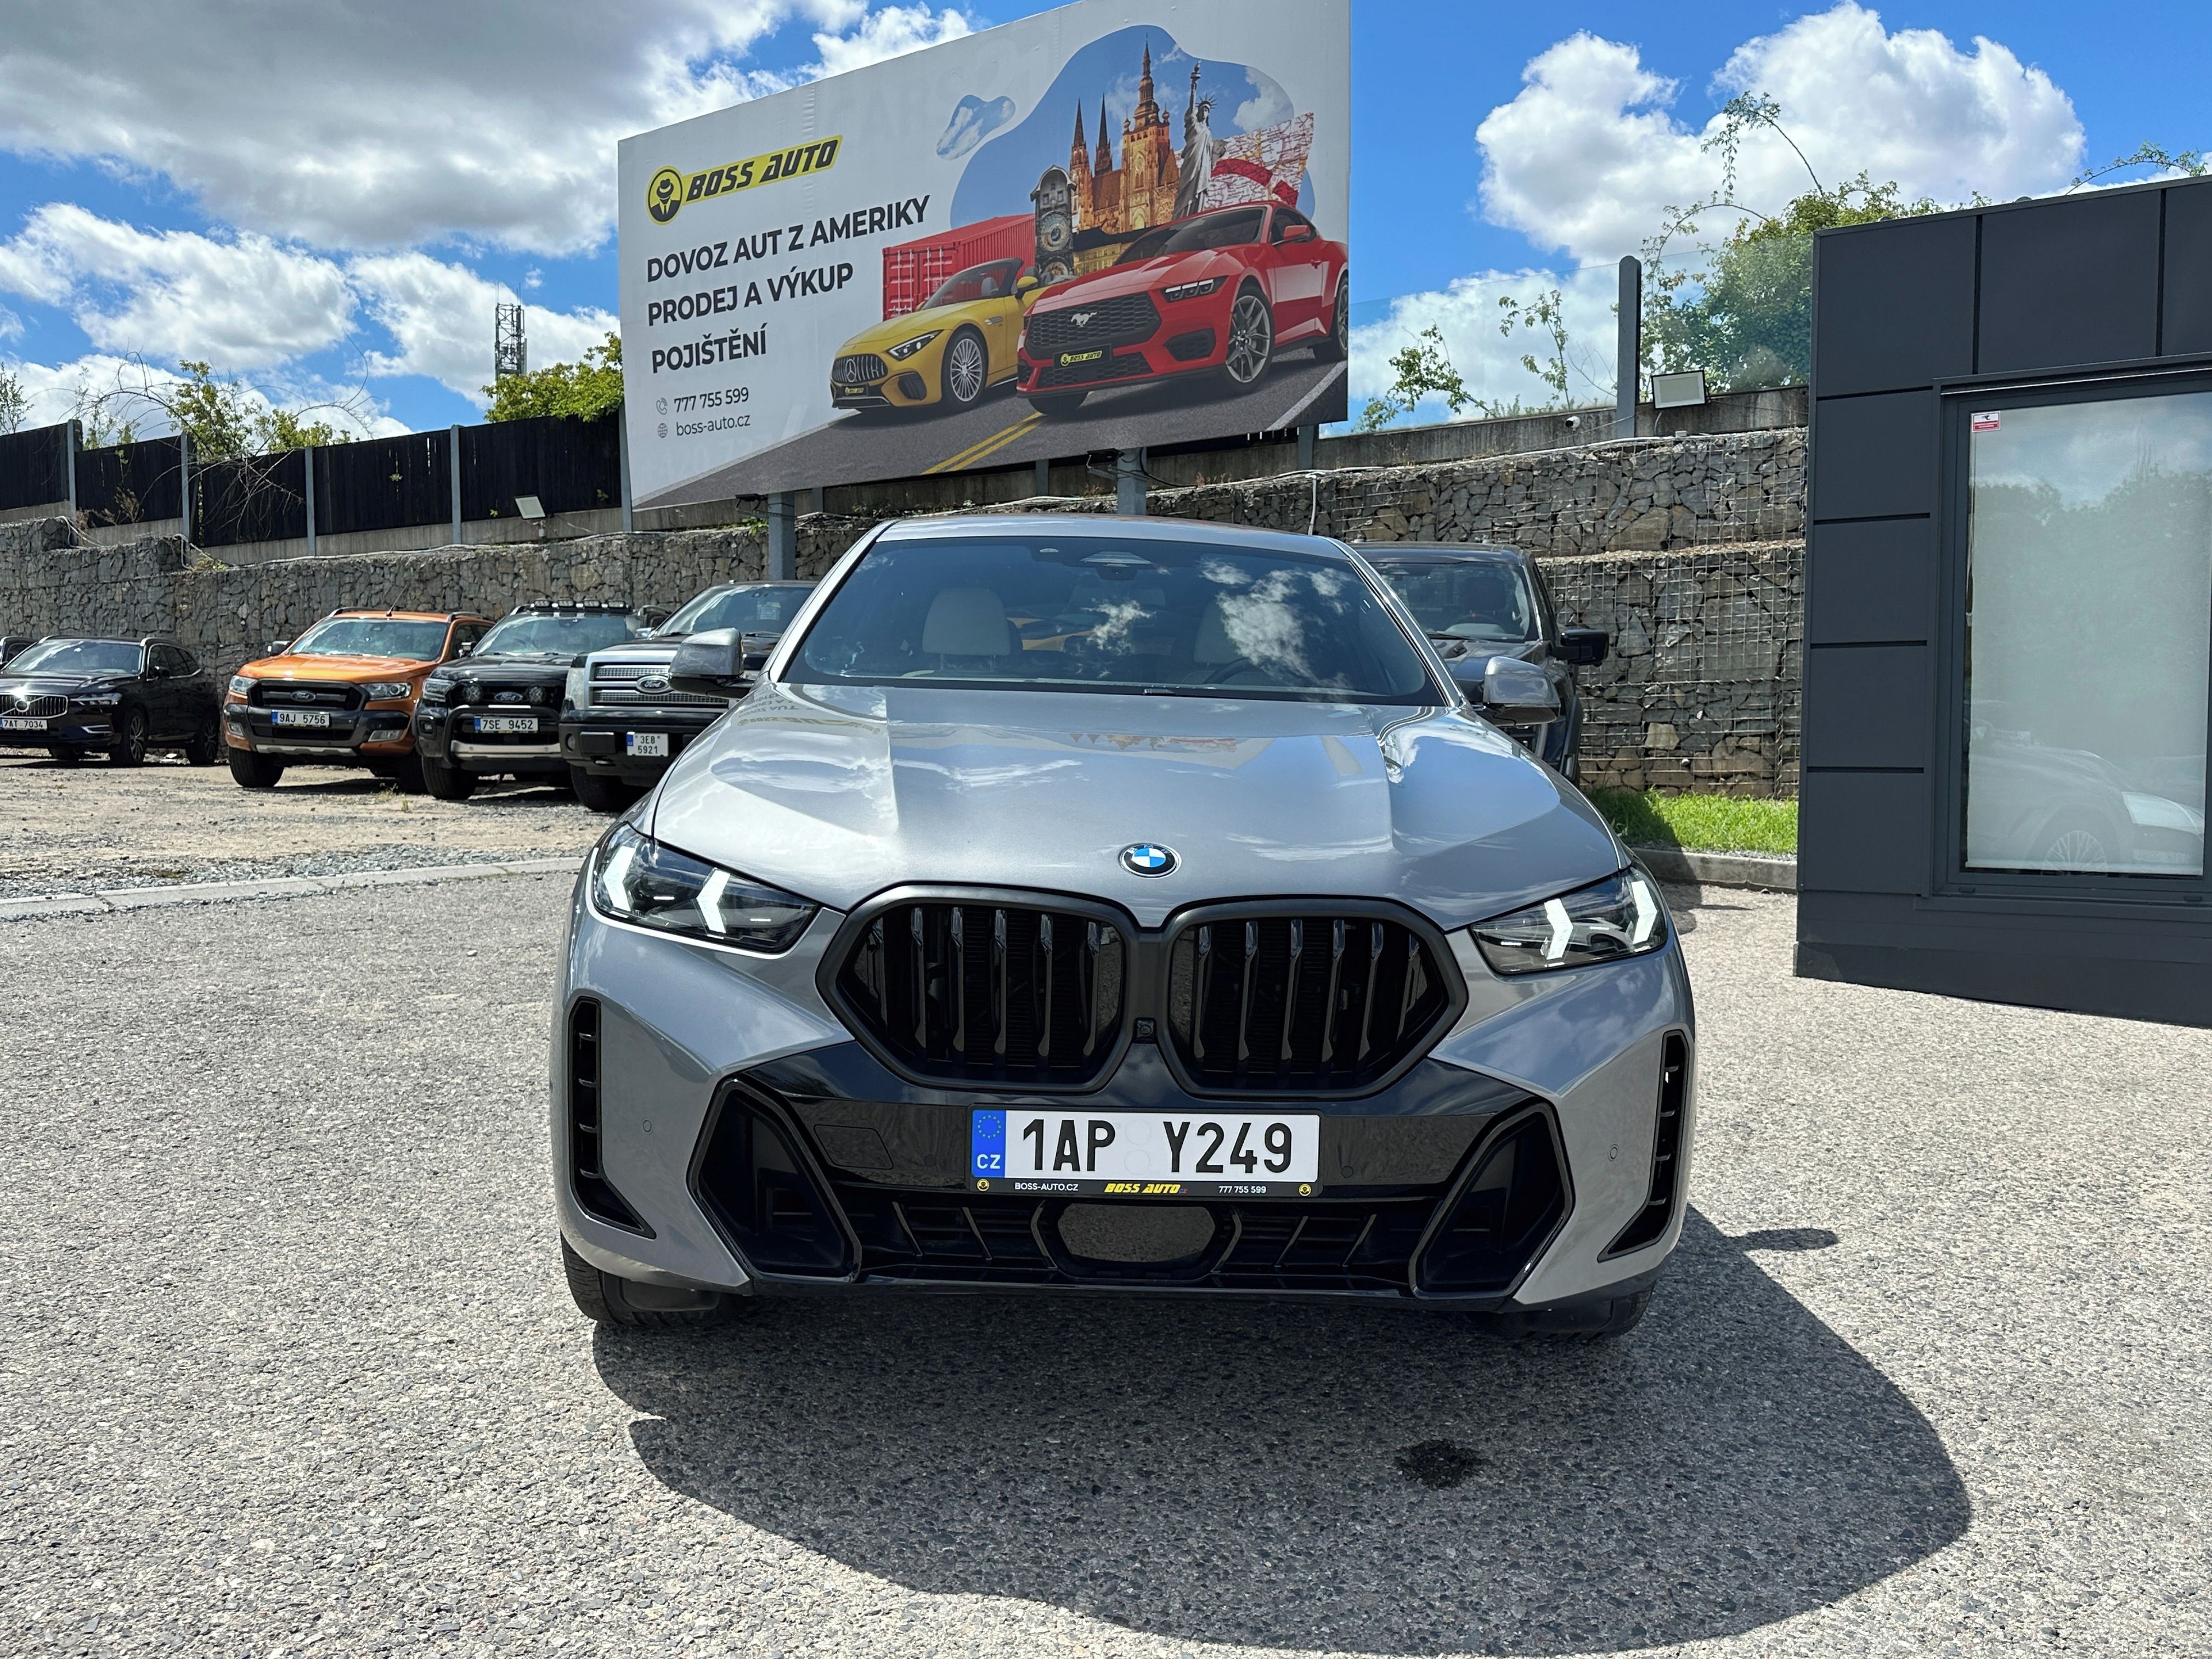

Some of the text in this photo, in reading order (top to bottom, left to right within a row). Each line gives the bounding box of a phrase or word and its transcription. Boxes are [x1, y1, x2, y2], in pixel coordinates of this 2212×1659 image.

[686, 139, 838, 202] BOSS AUTO
[647, 195, 930, 282] DOVOZ AUT Z AMERIKY
[648, 266, 854, 326] PRODEJ A VÝKUP
[652, 323, 768, 374] POJIŠTĚNÍ
[674, 387, 749, 413] 777 755 599
[676, 415, 751, 436] boss-auto.cz
[280, 714, 296, 723] 9AJ
[303, 715, 325, 724] 5756
[483, 720, 500, 730] 7SE
[509, 720, 533, 730] 9452
[637, 746, 658, 754] 5921
[977, 1119, 1292, 1173] CZ 1AP Y249
[1014, 1182, 1079, 1191] BOSS-AUTO.CZ
[1104, 1183, 1141, 1193] BOSS
[1142, 1183, 1181, 1194] AUTO
